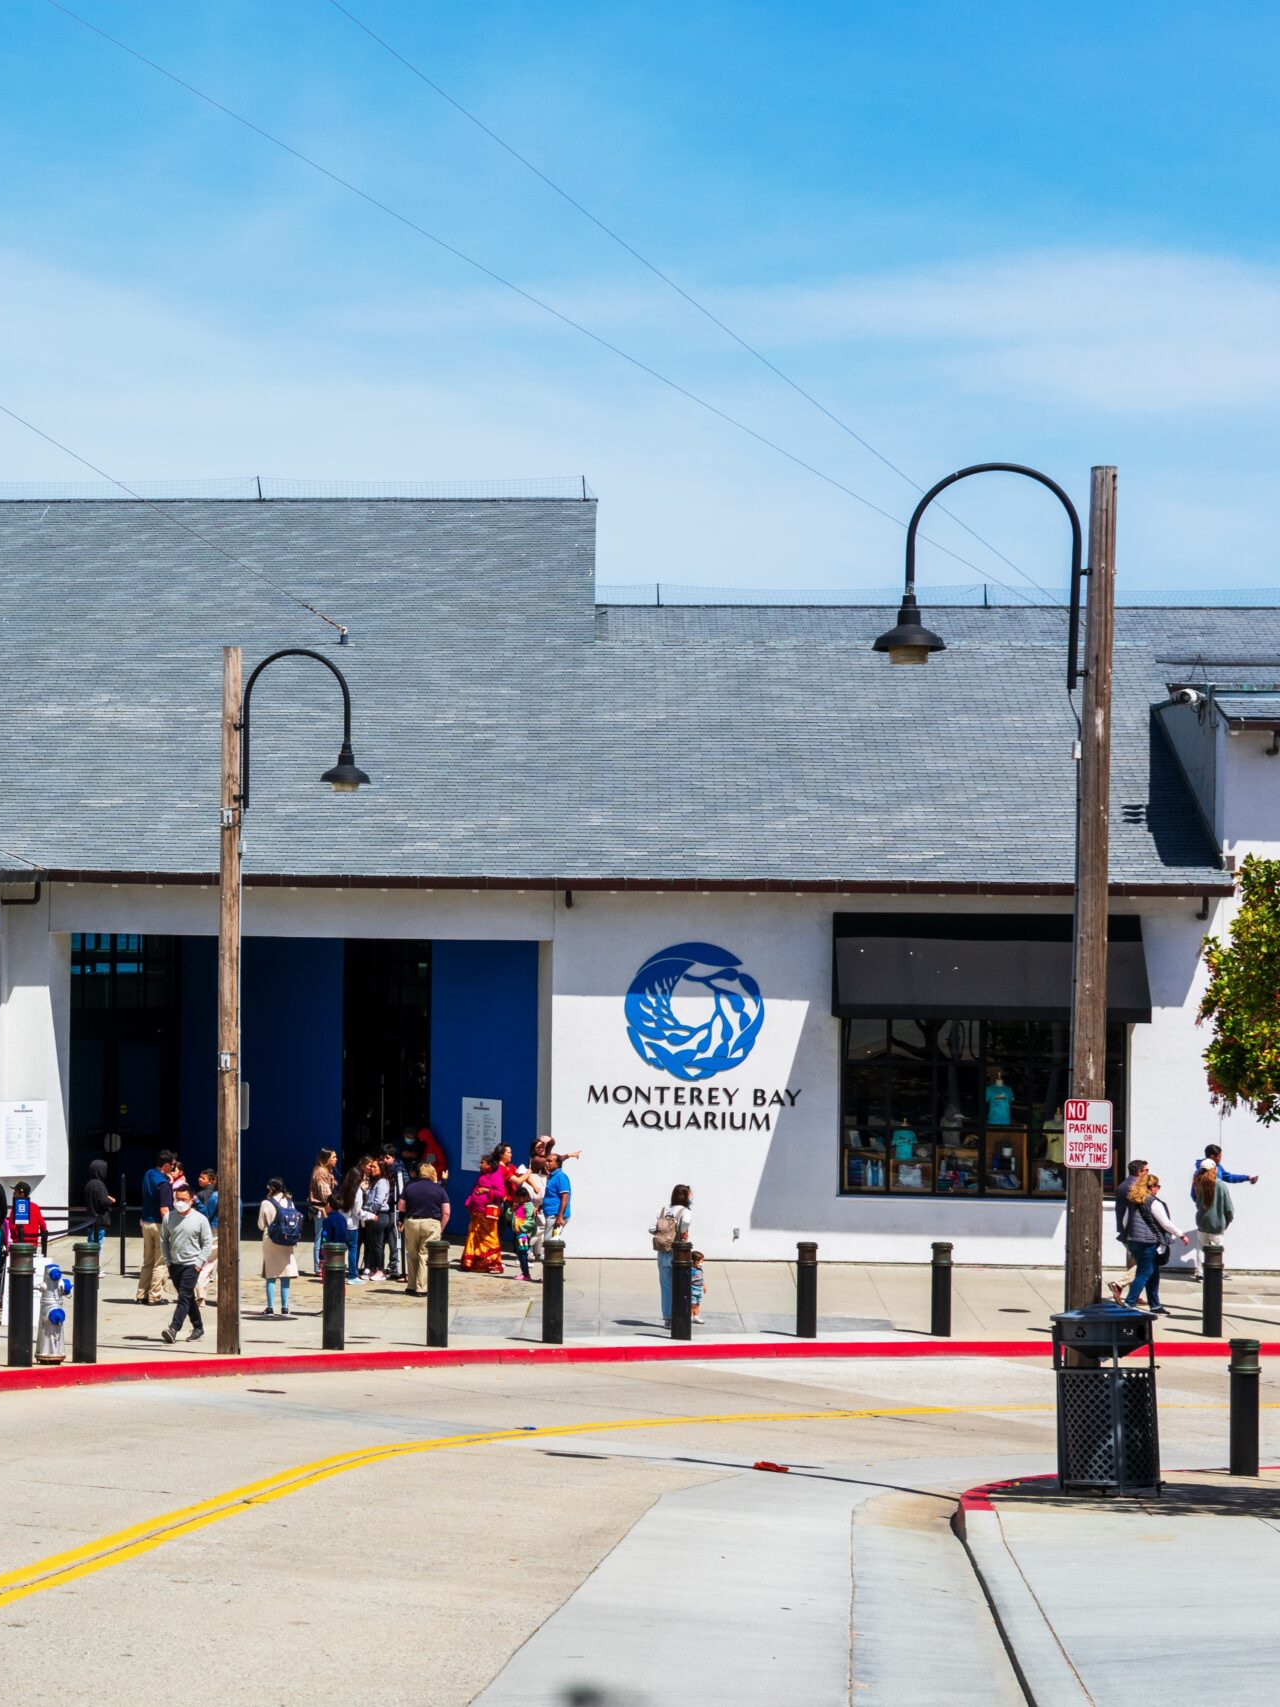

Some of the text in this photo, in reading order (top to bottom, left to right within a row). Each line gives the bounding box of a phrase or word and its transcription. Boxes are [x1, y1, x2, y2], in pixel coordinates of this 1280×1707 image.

[587, 1085, 802, 1107] MONTEREY BAY
[1068, 1102, 1085, 1119] NO
[622, 1110, 771, 1131] AQUARIUM
[1069, 1123, 1108, 1134] PARKING
[1069, 1142, 1108, 1153] STOPPING
[1069, 1153, 1107, 1164] ANY TIME
